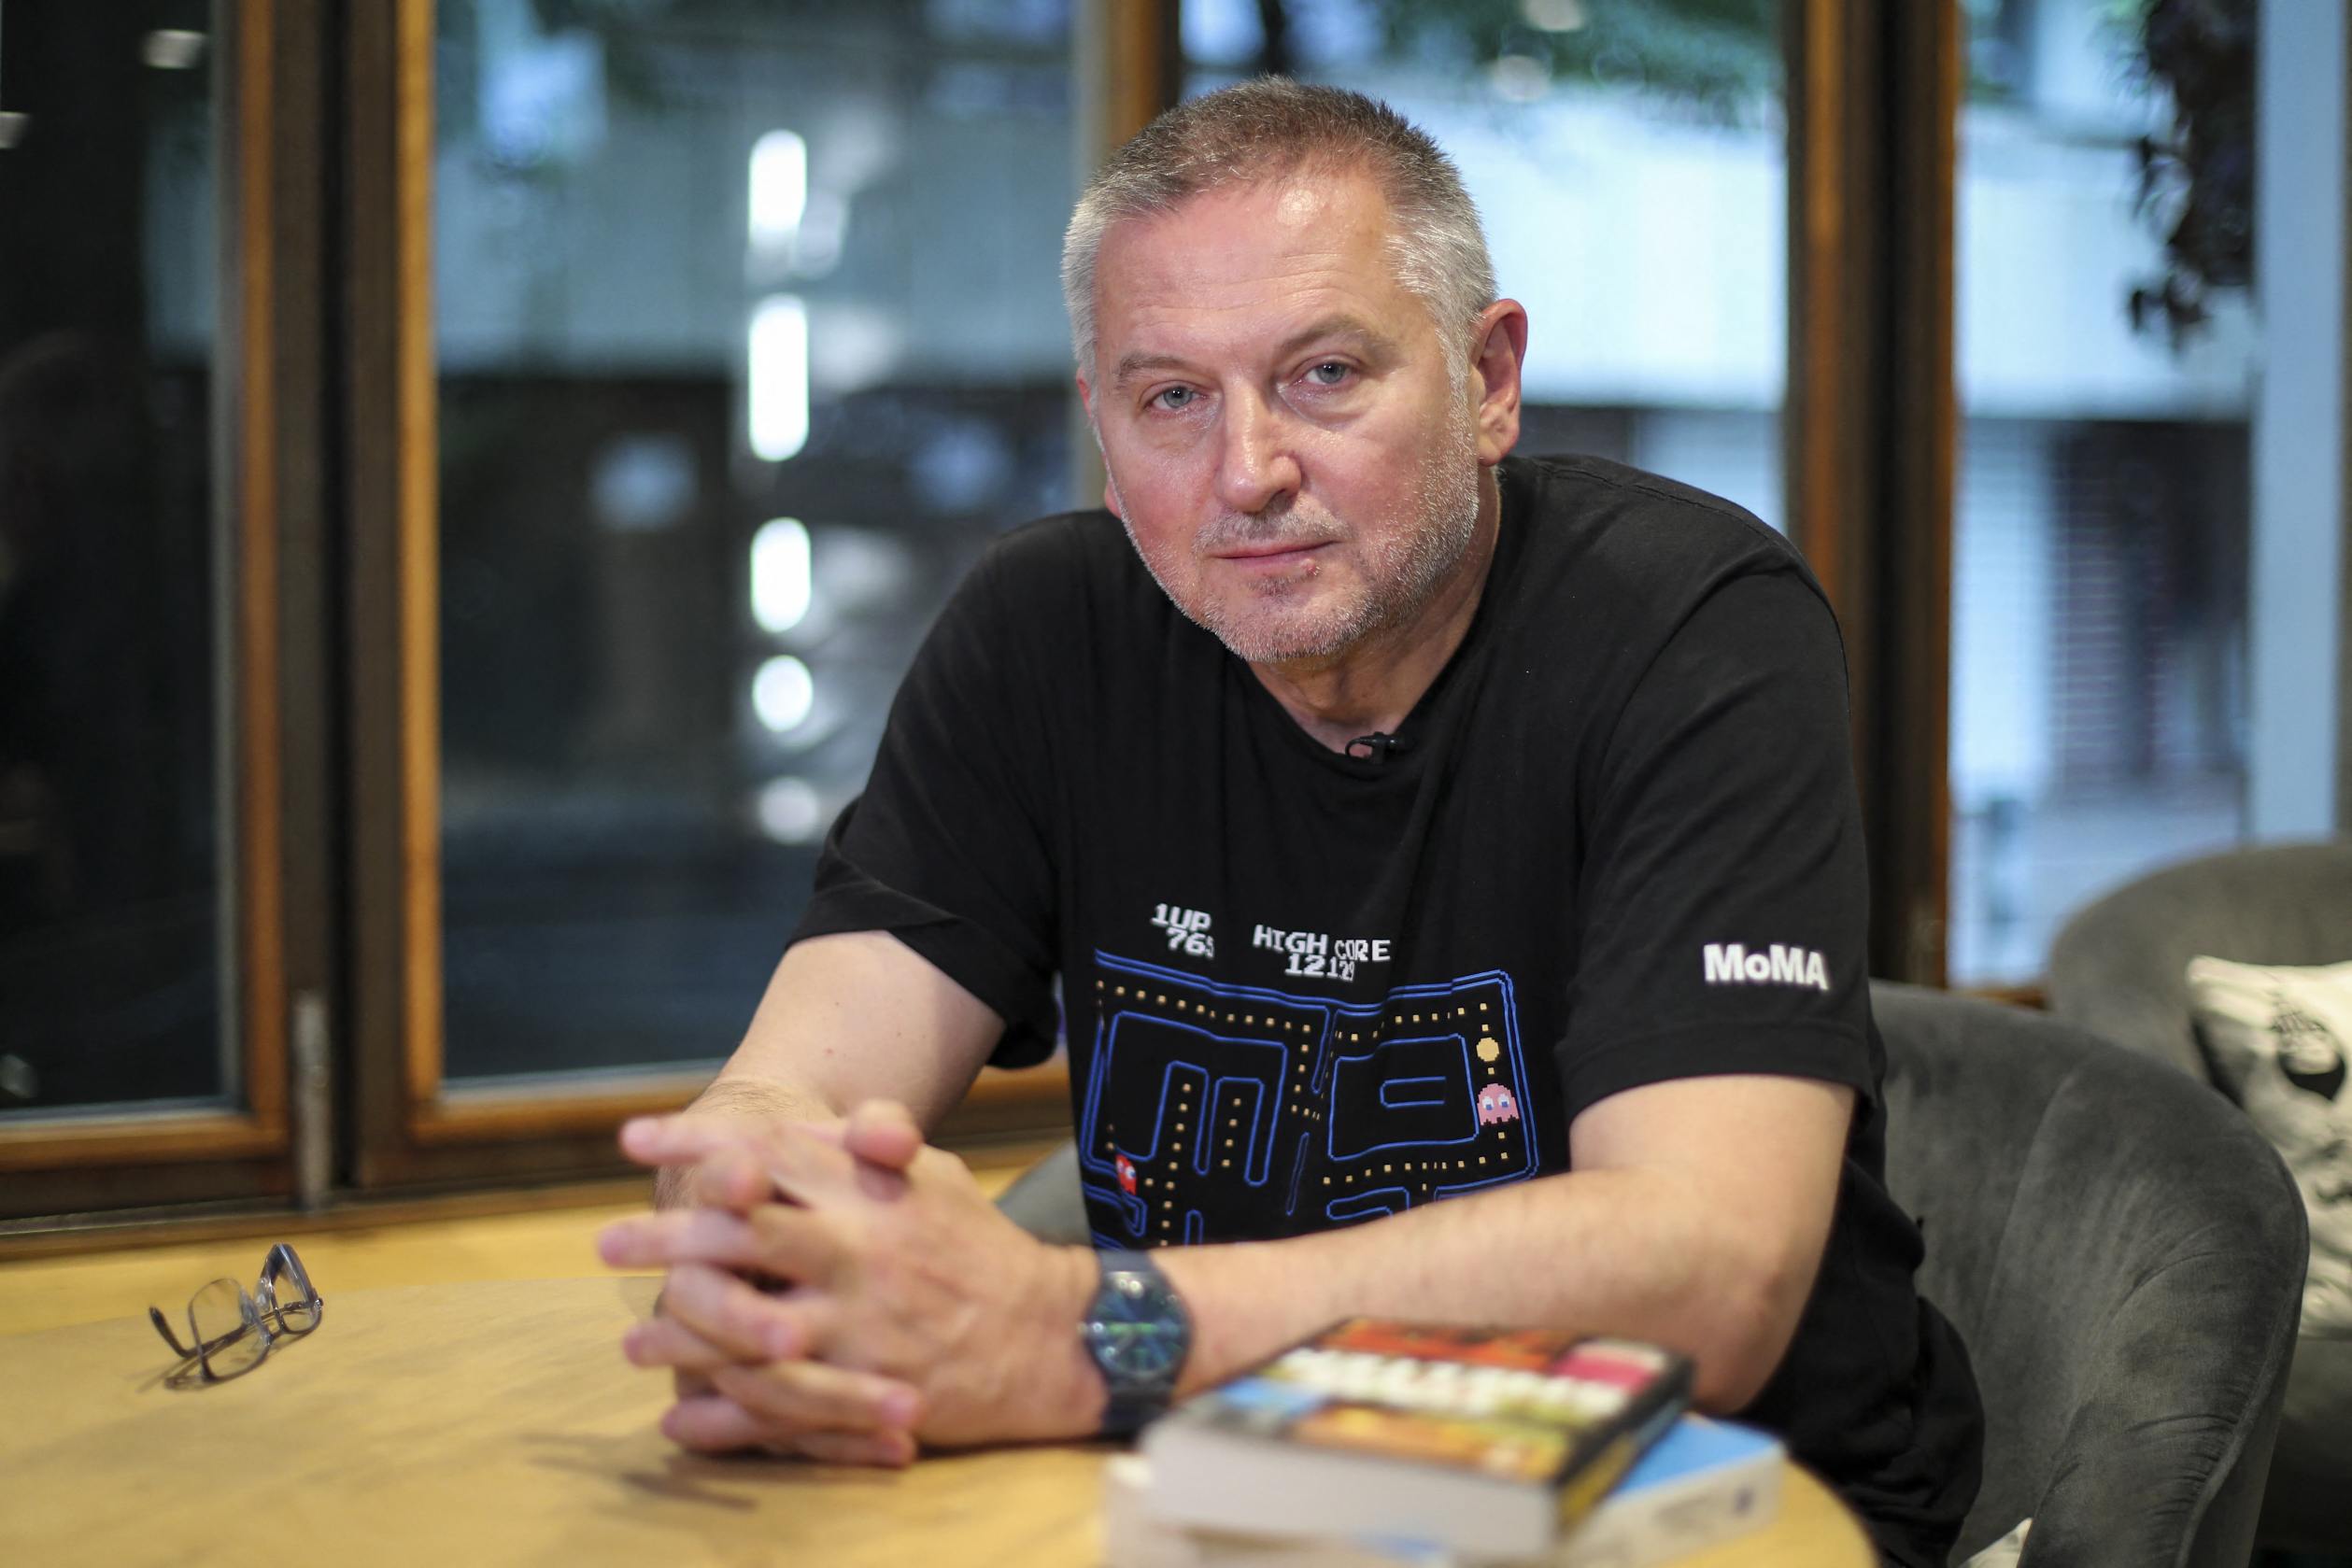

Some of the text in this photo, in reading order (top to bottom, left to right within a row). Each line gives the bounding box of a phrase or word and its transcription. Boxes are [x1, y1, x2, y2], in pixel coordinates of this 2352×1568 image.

[1151, 902, 1211, 932] 1UP
[1253, 923, 1328, 955] HIGH
[1703, 943, 1829, 991] MoMA
